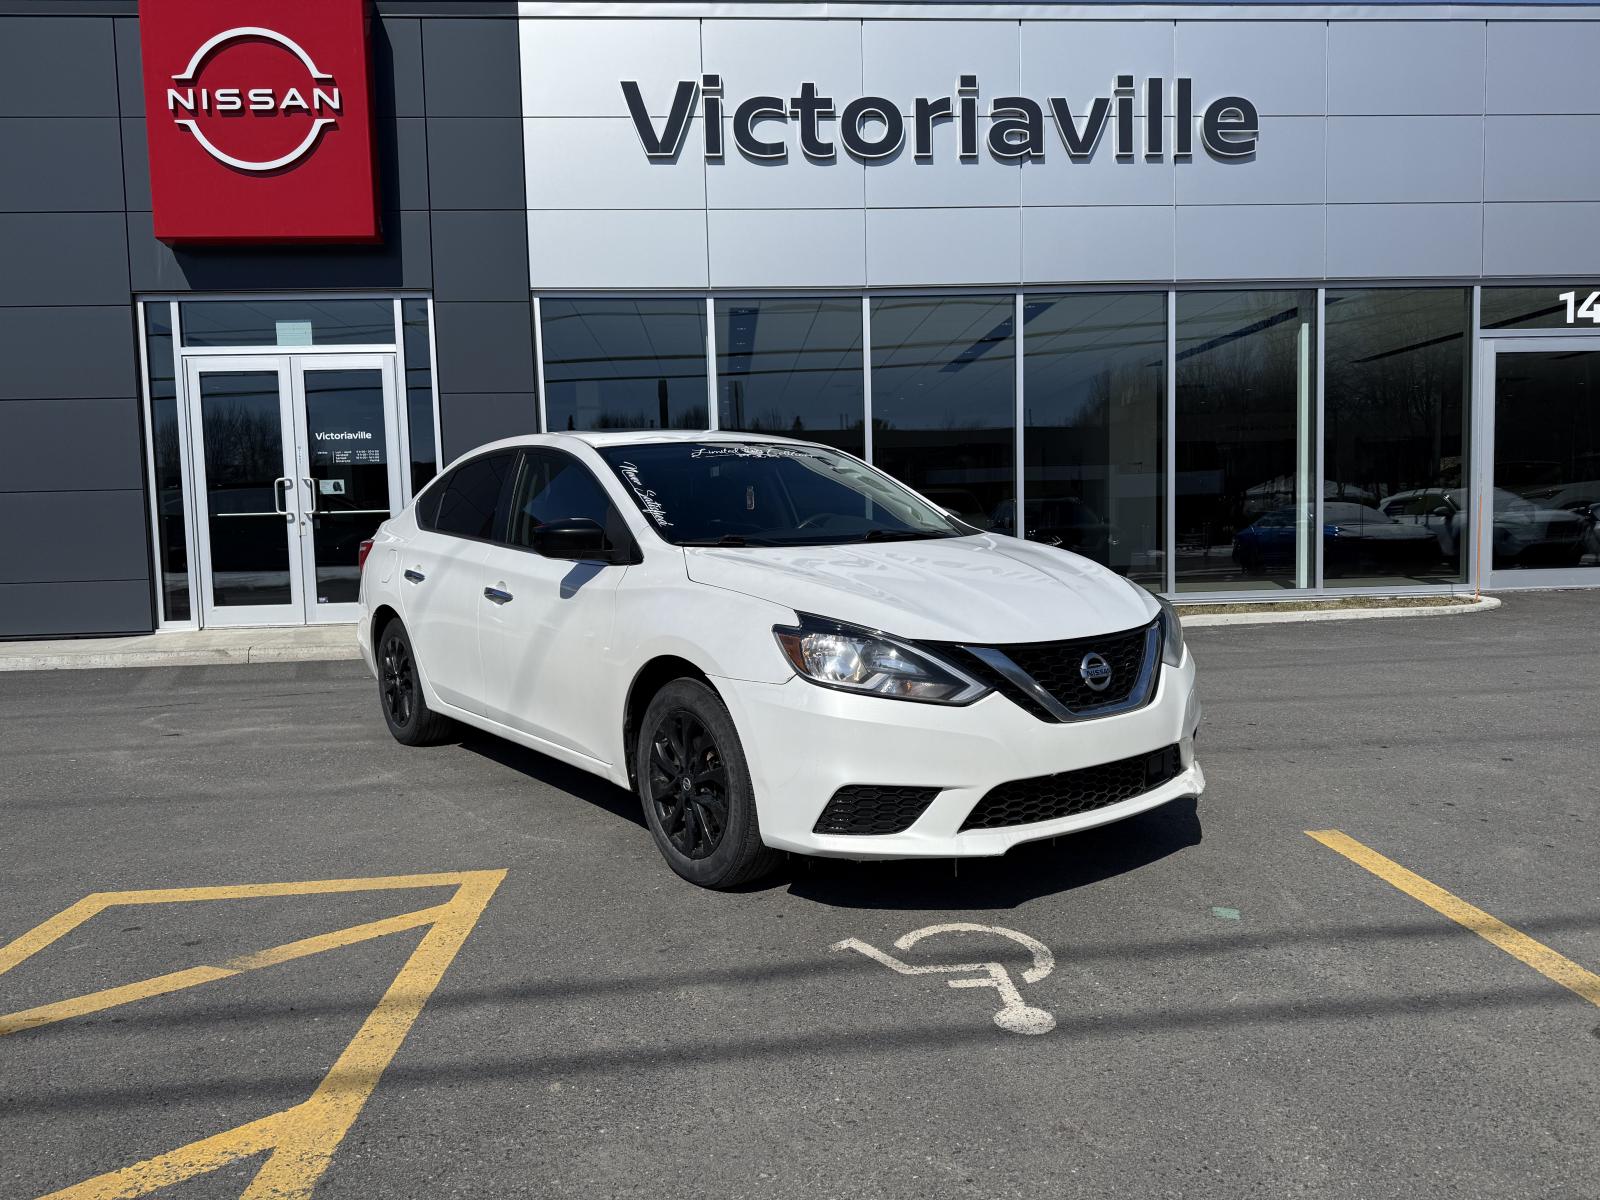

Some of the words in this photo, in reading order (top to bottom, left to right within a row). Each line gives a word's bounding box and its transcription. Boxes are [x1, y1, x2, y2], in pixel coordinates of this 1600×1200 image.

[167, 87, 341, 113] NISSAN
[620, 73, 1260, 159] Victoriaville
[315, 431, 372, 441] Victoriaville
